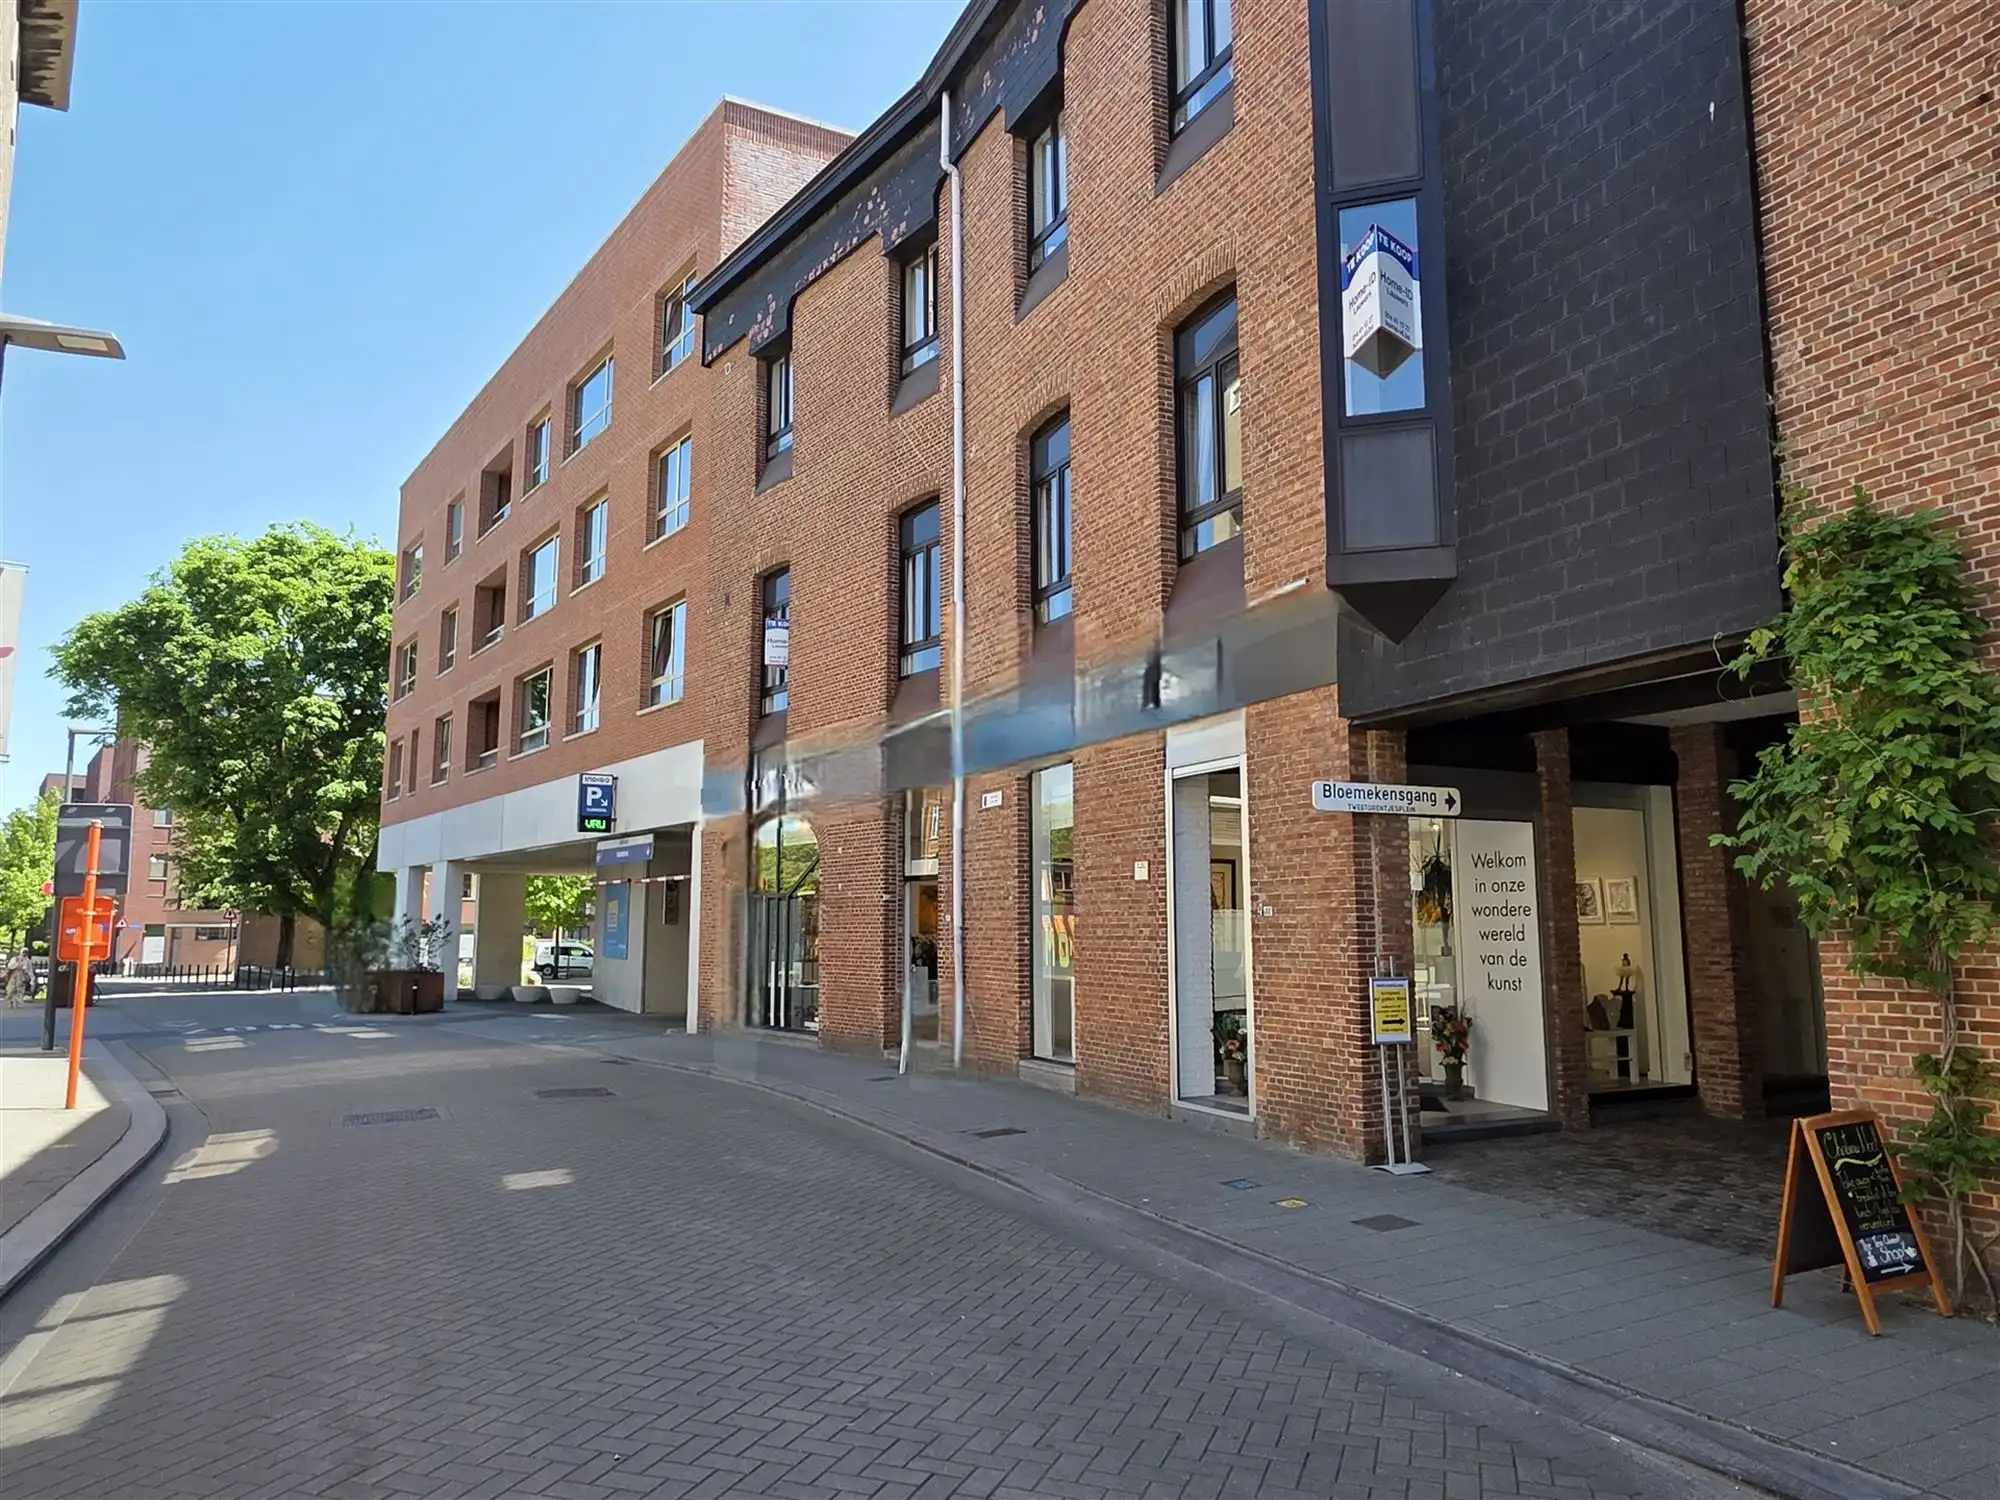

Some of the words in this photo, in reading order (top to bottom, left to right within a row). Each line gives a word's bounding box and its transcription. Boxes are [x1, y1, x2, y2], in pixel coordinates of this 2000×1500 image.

[1378, 231, 1389, 247] TE
[1389, 240, 1412, 263] KOOP
[1346, 256, 1356, 274] TE
[1380, 268, 1414, 301] Home-ID
[586, 787, 602, 806] P
[1322, 783, 1438, 807] Bloemekensgang
[1471, 850, 1527, 870] Welkom
[1474, 878, 1487, 893] in
[1491, 880, 1526, 893] onze
[1471, 899, 1532, 917] wondere
[1479, 925, 1526, 942] wereld
[1480, 954, 1504, 966] van
[1509, 949, 1528, 967] de
[1487, 973, 1523, 992] kunst
